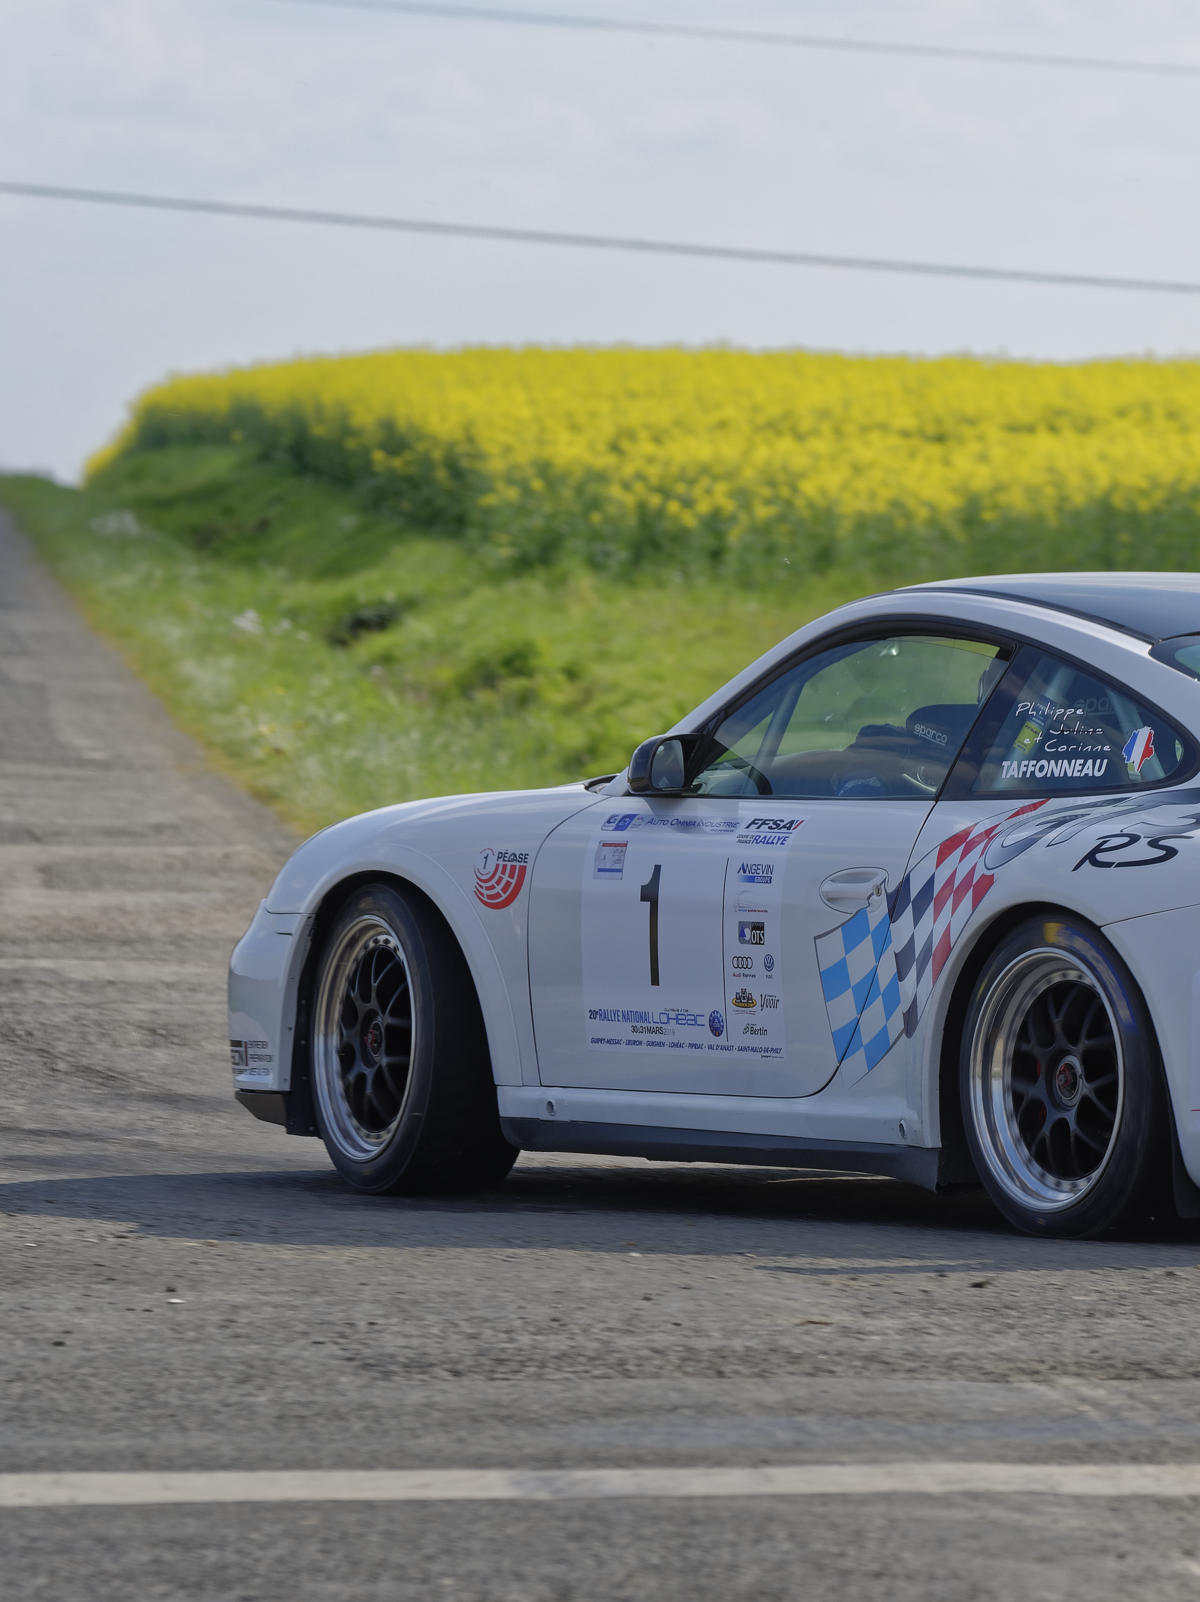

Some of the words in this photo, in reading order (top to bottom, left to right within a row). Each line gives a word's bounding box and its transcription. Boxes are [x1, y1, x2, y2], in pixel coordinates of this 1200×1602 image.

[1015, 702, 1085, 721] Philippe
[914, 723, 948, 743] sparco
[1045, 739, 1112, 752] Corinne
[1000, 759, 1109, 778] TAFFONNEAU
[745, 818, 797, 831] FFSA
[752, 834, 791, 846] RALLYE
[1072, 833, 1195, 871] RS
[737, 862, 774, 875] ANGEVIN
[640, 864, 661, 986] 1
